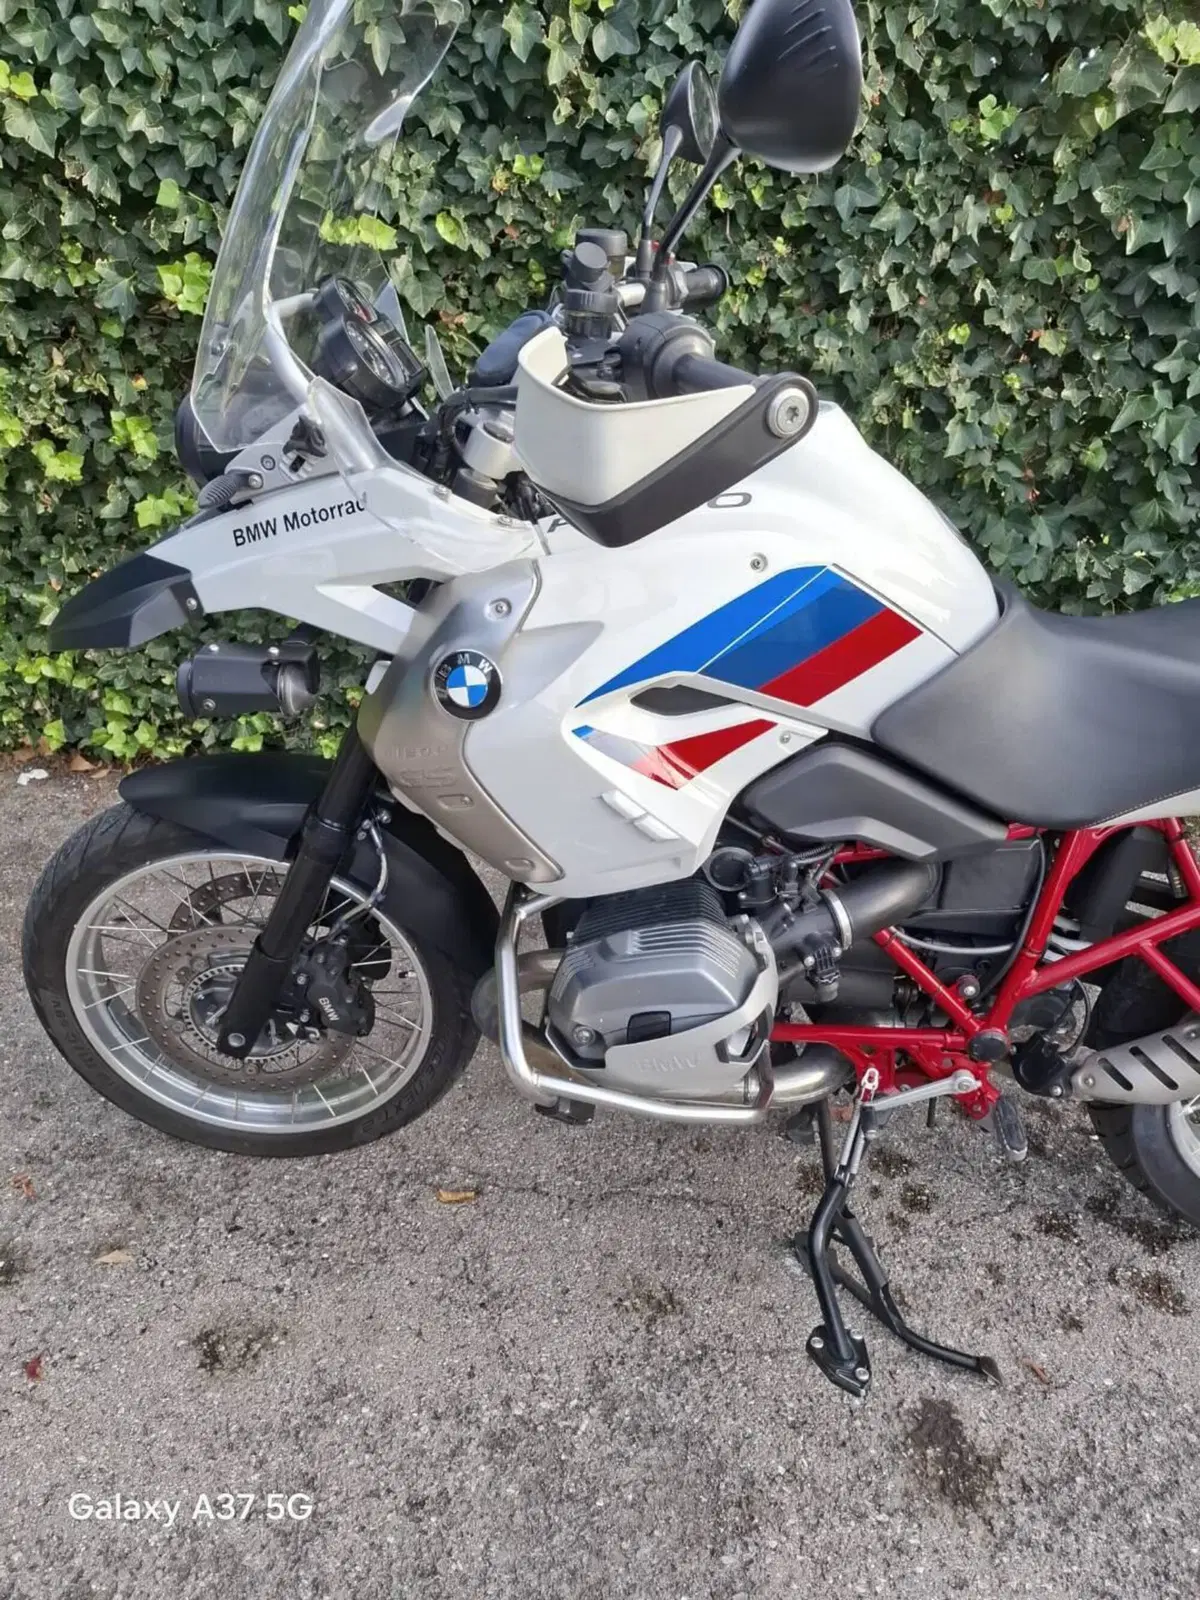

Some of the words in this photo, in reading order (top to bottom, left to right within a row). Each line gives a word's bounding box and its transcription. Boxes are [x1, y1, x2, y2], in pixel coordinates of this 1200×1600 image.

[232, 518, 278, 547] BMW
[437, 653, 493, 681] BMW
[318, 997, 340, 1021] BMW
